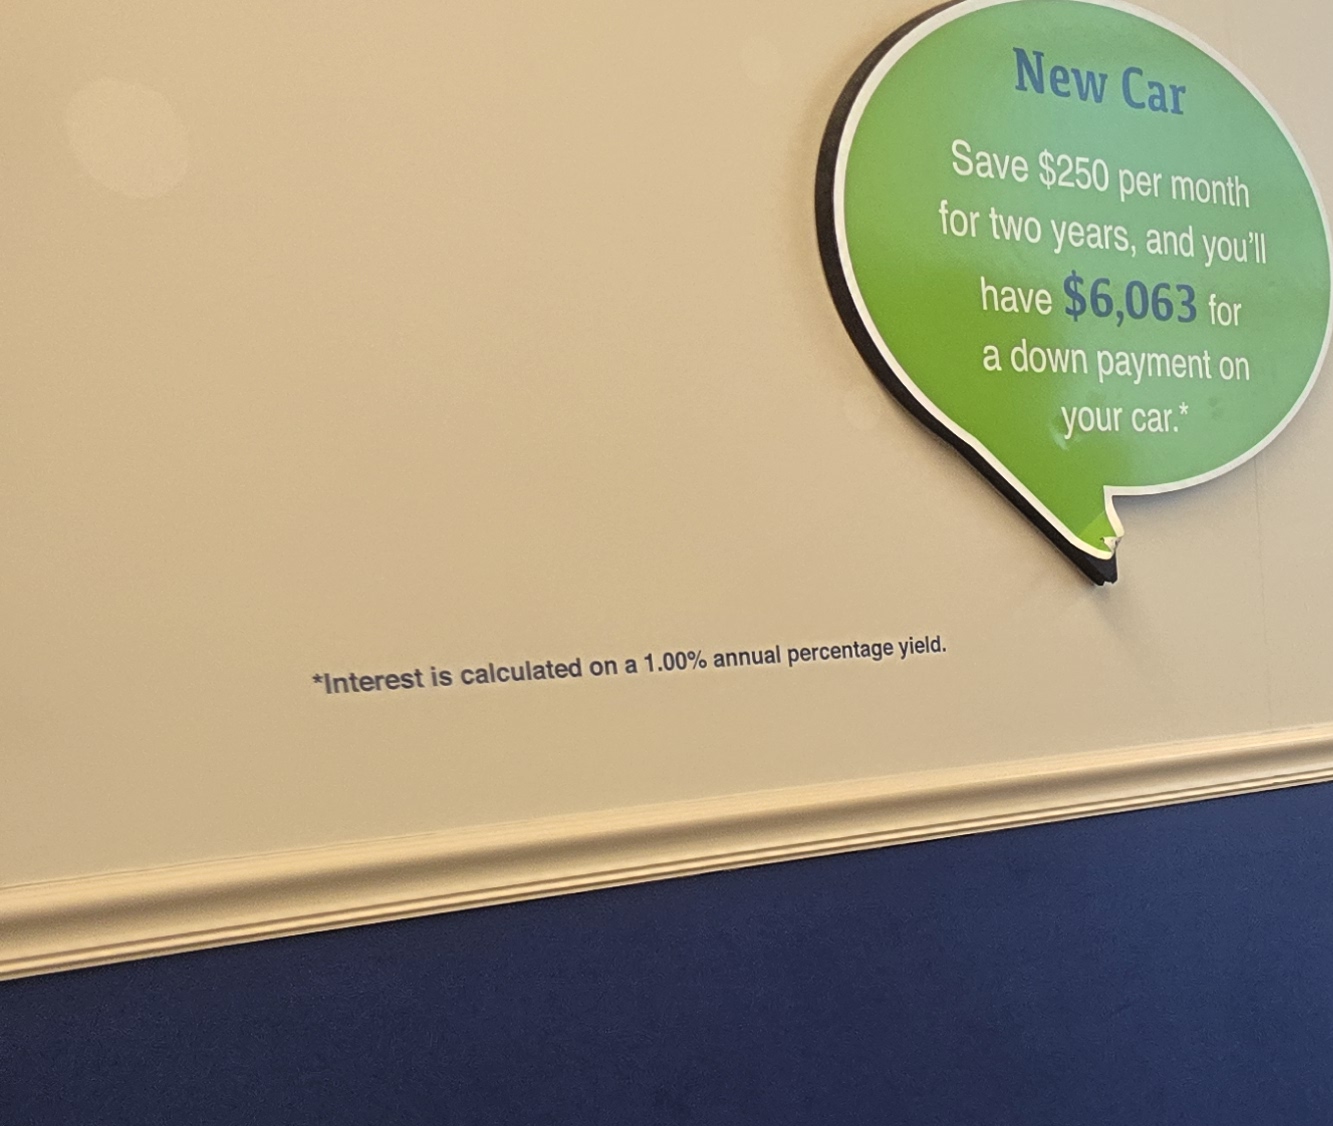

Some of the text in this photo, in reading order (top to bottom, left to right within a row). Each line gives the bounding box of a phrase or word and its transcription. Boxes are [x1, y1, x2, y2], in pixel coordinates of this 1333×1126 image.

[1013, 47, 1186, 115] New Car
[952, 139, 1249, 207] Save $250 per month
[939, 201, 979, 236] for
[990, 207, 1041, 243] two
[1052, 218, 1137, 258] years,
[1145, 225, 1194, 257] and
[980, 270, 1242, 327] have $6,063 for
[982, 339, 1250, 384] a down payment on
[1061, 406, 1121, 439] your
[432, 669, 453, 688] is
[461, 661, 583, 686] calculated
[590, 660, 617, 677] on
[624, 658, 638, 674] a
[644, 649, 708, 673] 1.00%
[713, 645, 781, 669] annual
[787, 639, 894, 668] percentage
[898, 635, 947, 660] yield.
